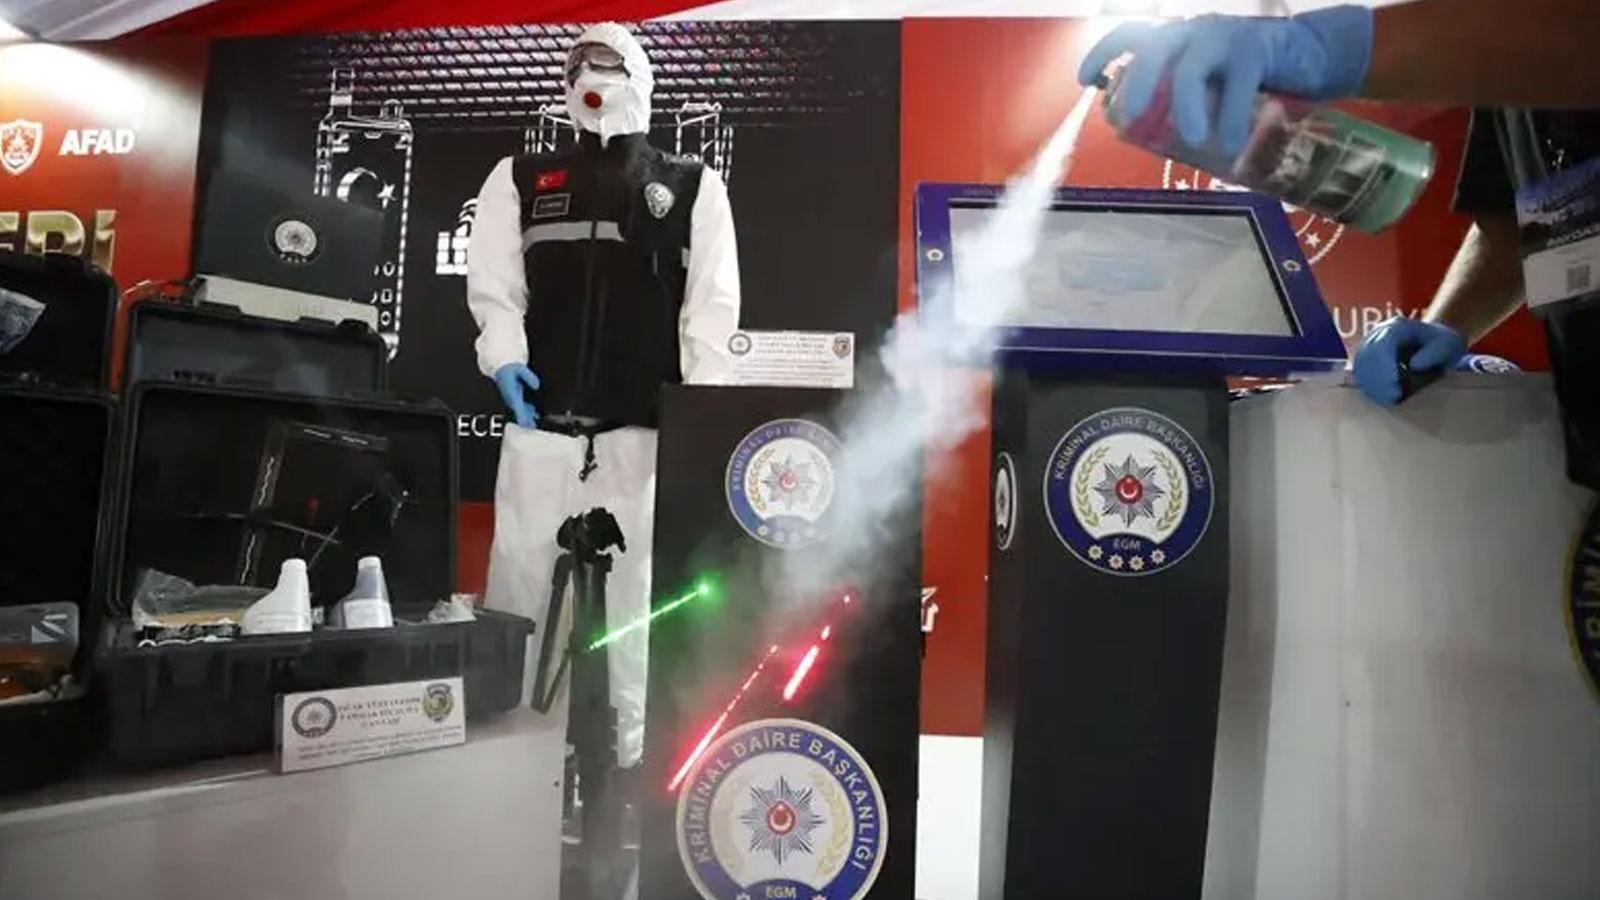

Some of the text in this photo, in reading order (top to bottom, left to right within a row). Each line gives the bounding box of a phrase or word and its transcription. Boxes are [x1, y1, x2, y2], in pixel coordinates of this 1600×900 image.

[59, 129, 136, 155] AFAD
[1113, 538, 1142, 550] EGM
[732, 730, 802, 759] DAİRE
[807, 738, 875, 871] BAŞKANLIĞI
[765, 886, 797, 899] EGM
